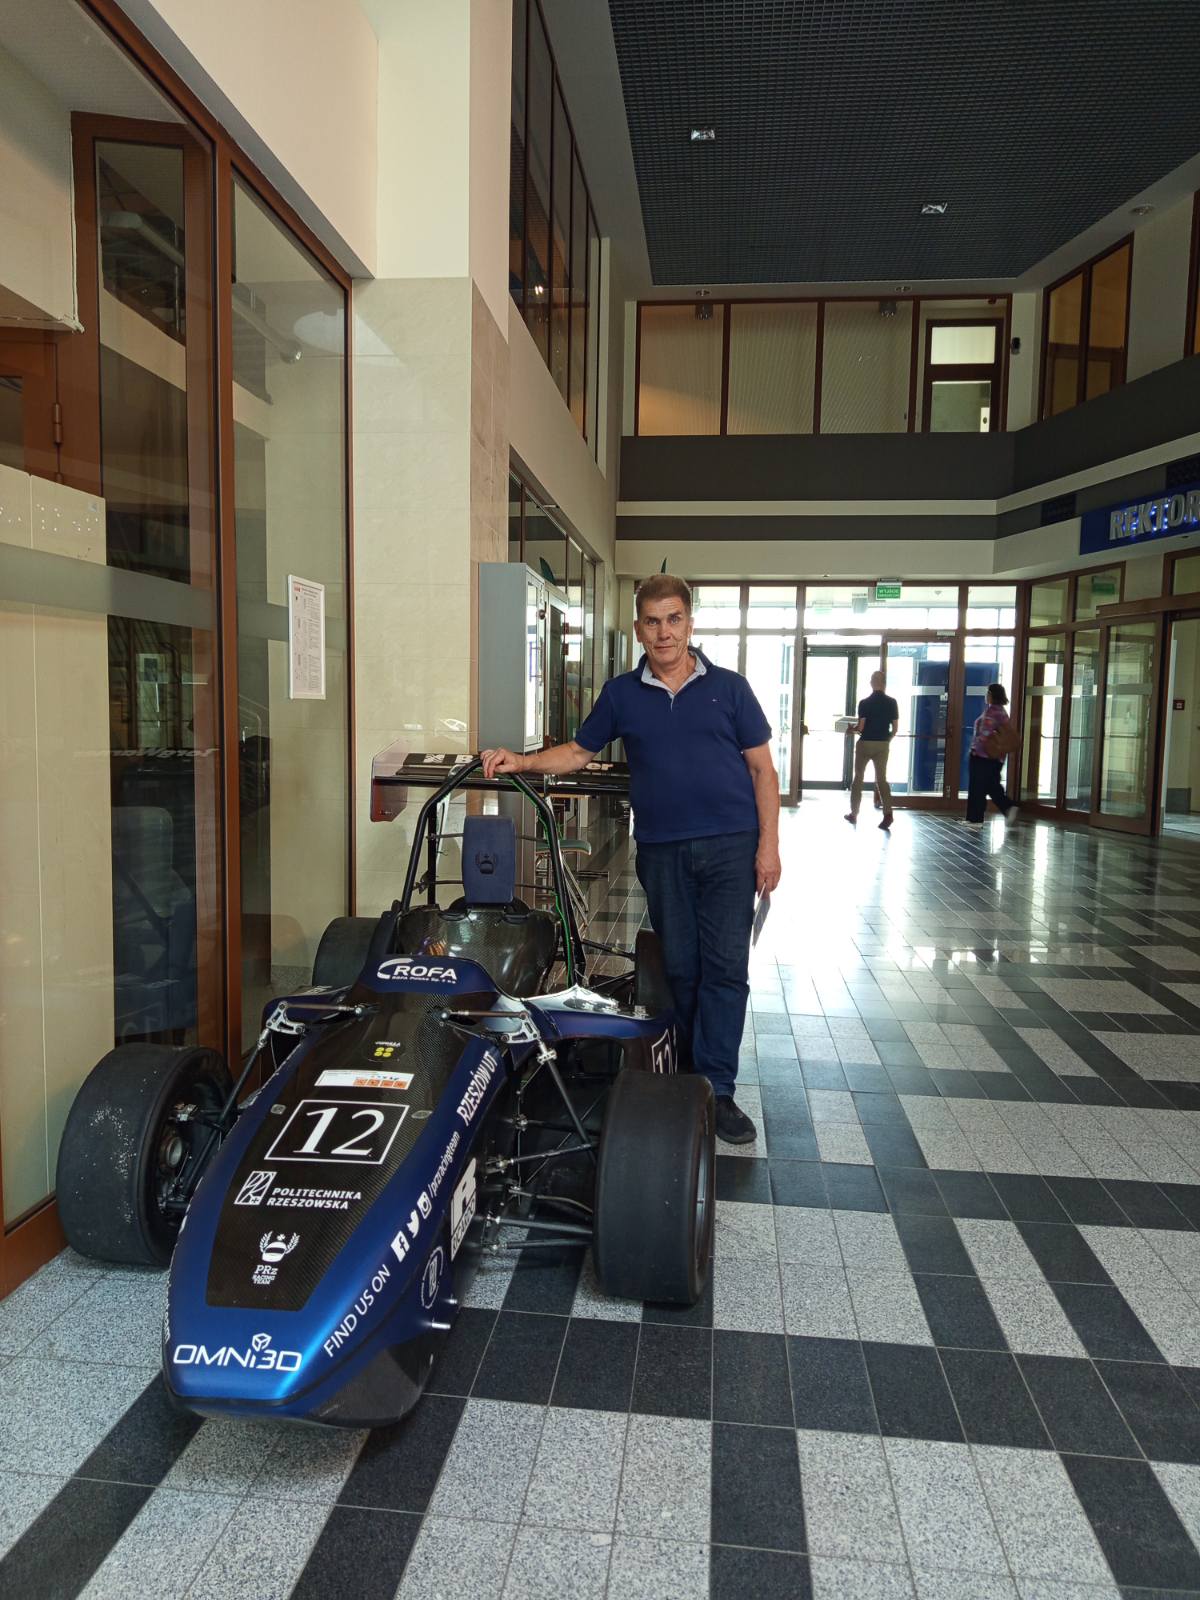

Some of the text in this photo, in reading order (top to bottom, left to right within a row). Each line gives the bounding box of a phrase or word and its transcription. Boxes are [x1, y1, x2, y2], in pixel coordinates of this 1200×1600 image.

[481, 1050, 498, 1073] UT
[293, 1107, 385, 1156] 12
[266, 1197, 349, 1210] RZESZOWSKA
[272, 1187, 362, 1200] POLITECHNIKA
[323, 1264, 391, 1358] FIND US ON
